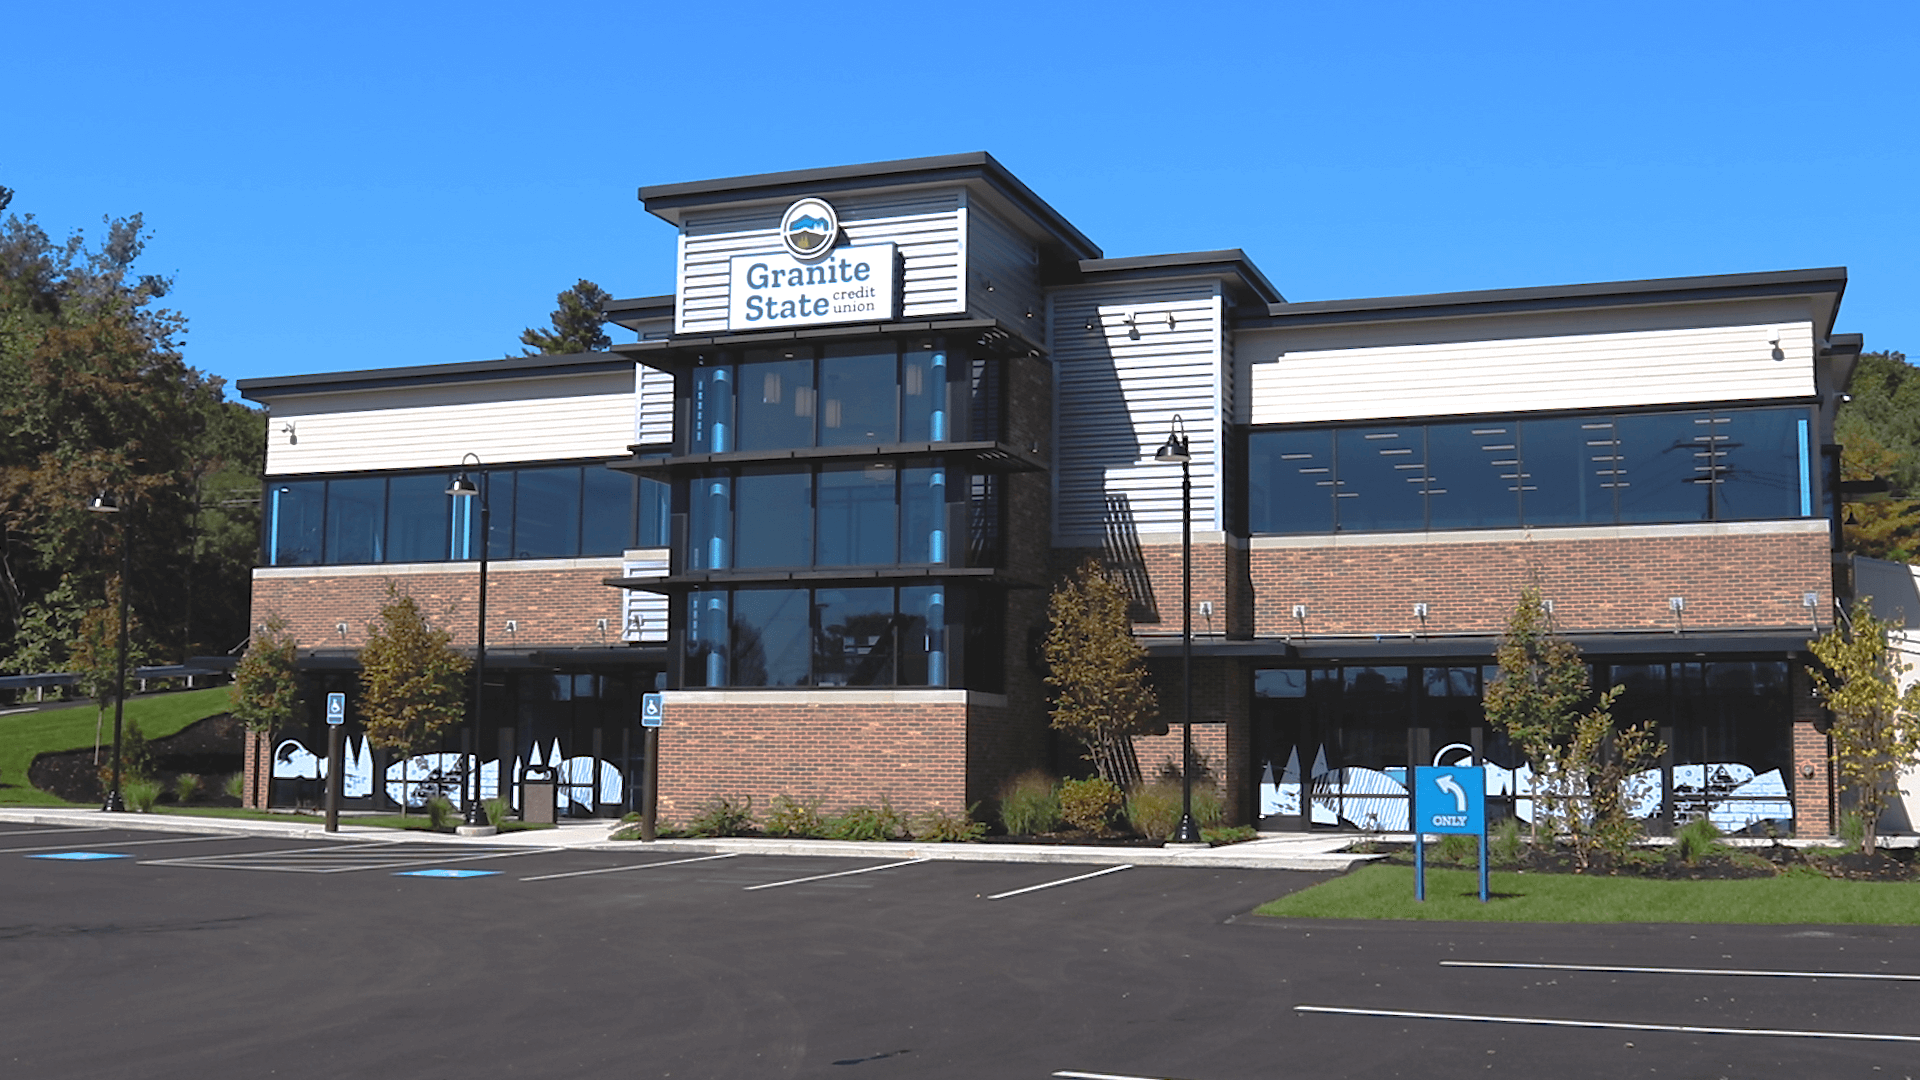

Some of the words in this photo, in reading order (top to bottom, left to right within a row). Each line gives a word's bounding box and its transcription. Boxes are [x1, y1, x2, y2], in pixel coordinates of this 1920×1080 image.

[746, 257, 870, 290] Granite
[833, 286, 876, 300] credit
[745, 294, 829, 321] State
[833, 302, 875, 313] union
[1432, 815, 1468, 827] ONLY
